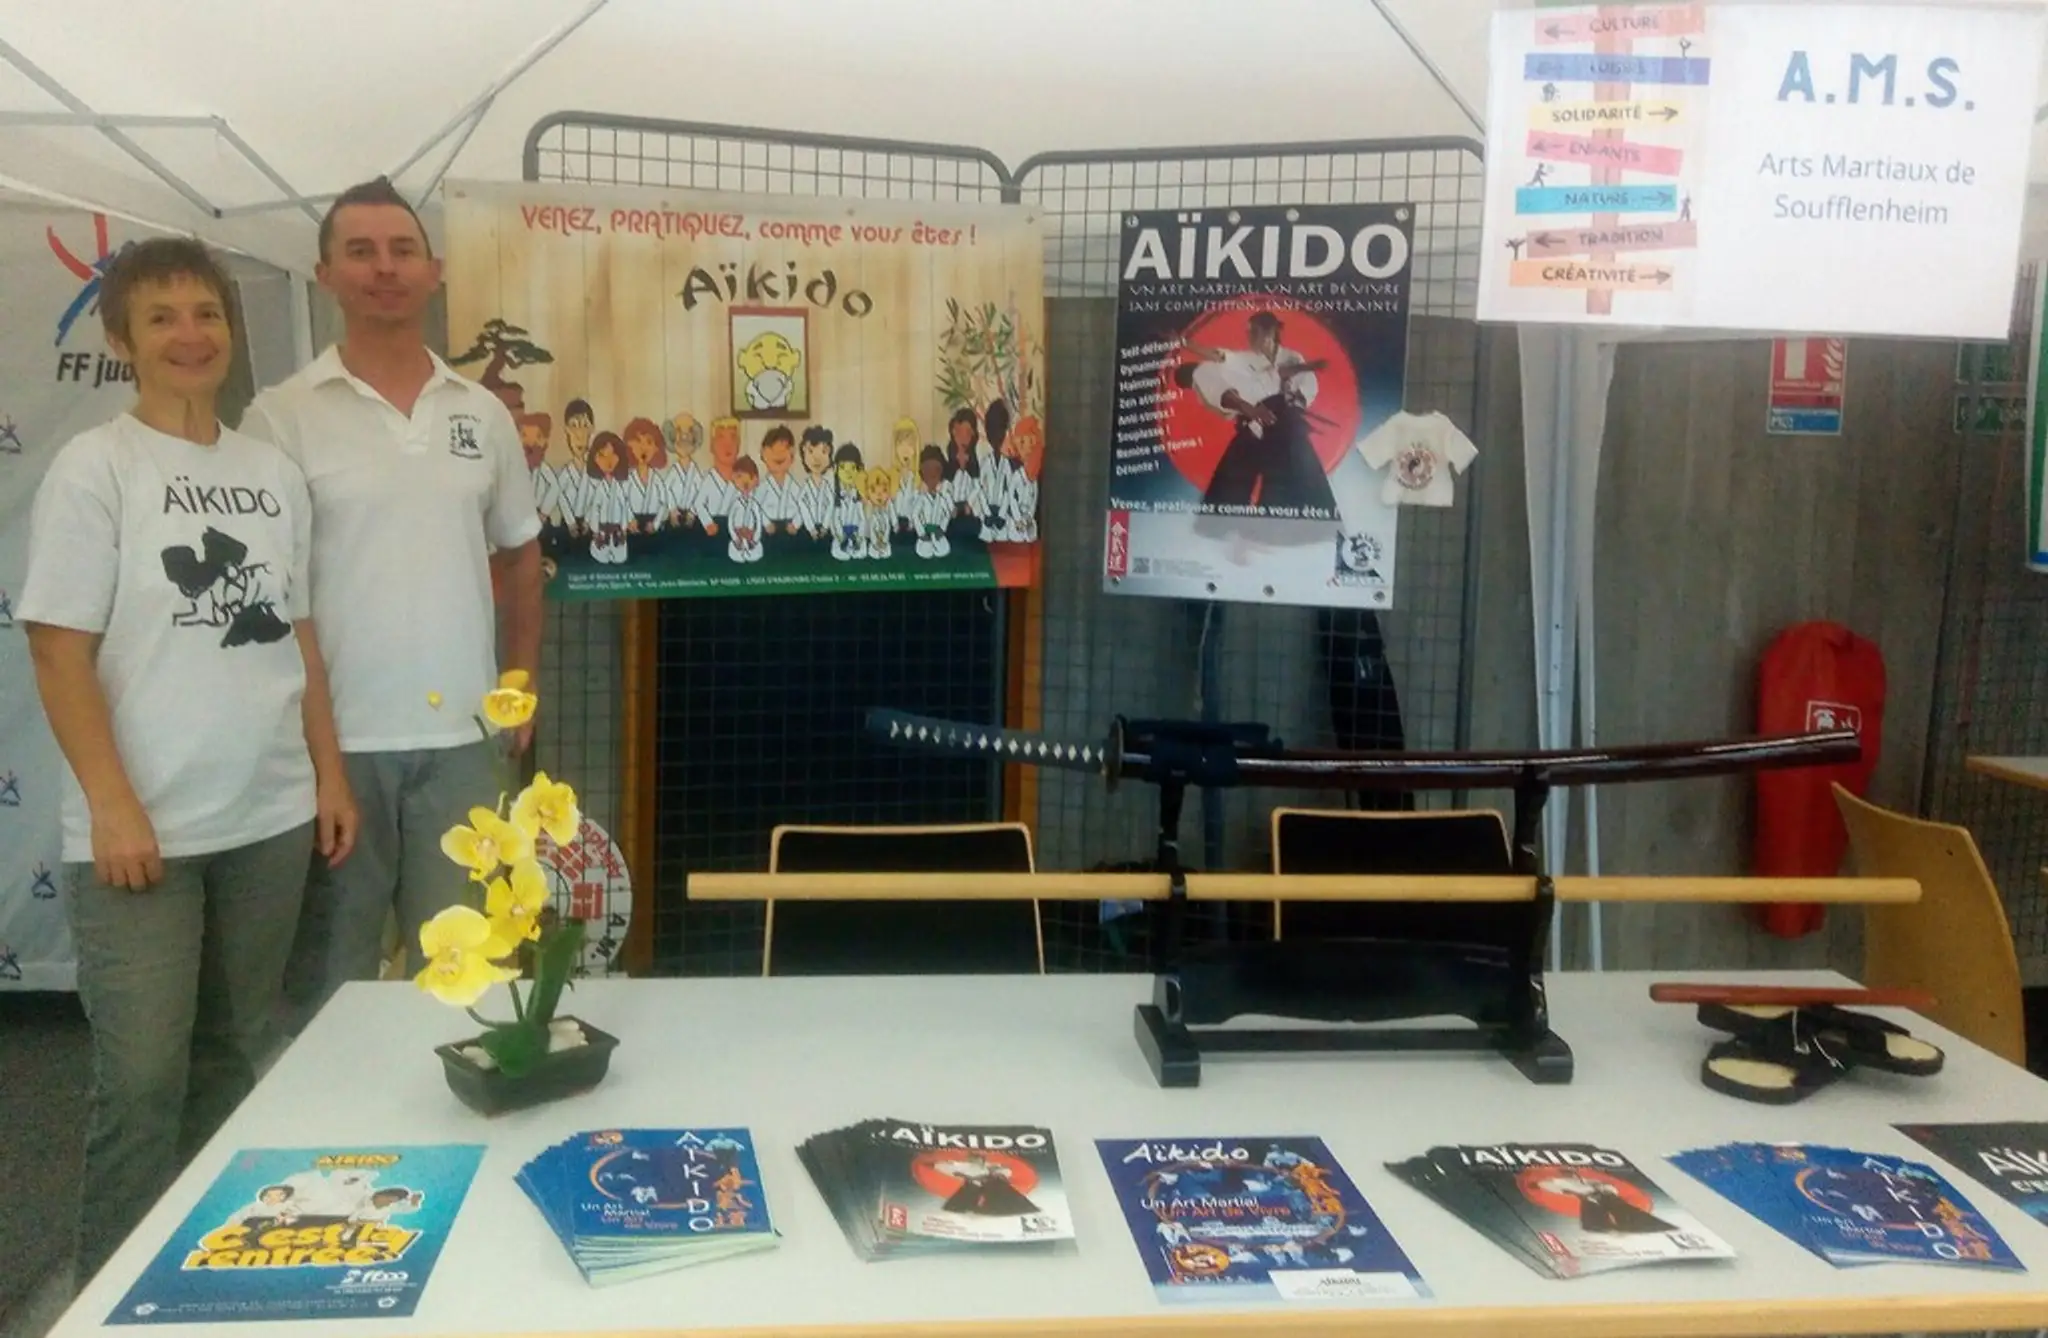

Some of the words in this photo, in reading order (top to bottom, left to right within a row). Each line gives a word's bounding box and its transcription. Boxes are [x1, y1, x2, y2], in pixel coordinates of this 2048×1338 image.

[1590, 16, 1660, 33] CULTURE
[1776, 50, 1975, 111] A.M.S.
[1758, 152, 1813, 178] Arts
[1822, 154, 1938, 183] Martiaux
[1945, 160, 1976, 185] de
[1773, 193, 1949, 225] Soufflenheim
[610, 208, 751, 242] PRATIQUEZ,
[759, 220, 843, 248] comme
[851, 224, 903, 243] vous
[911, 219, 963, 246] êtes
[1578, 229, 1664, 247] TRADITION
[1123, 212, 1409, 280] AÏKIDO
[676, 260, 874, 319] Aïkido
[93, 352, 134, 389] jud
[163, 475, 281, 518] AÏKIDO
[1122, 1140, 1250, 1164] Aïkido
[1201, 1196, 1260, 1209] Martial
